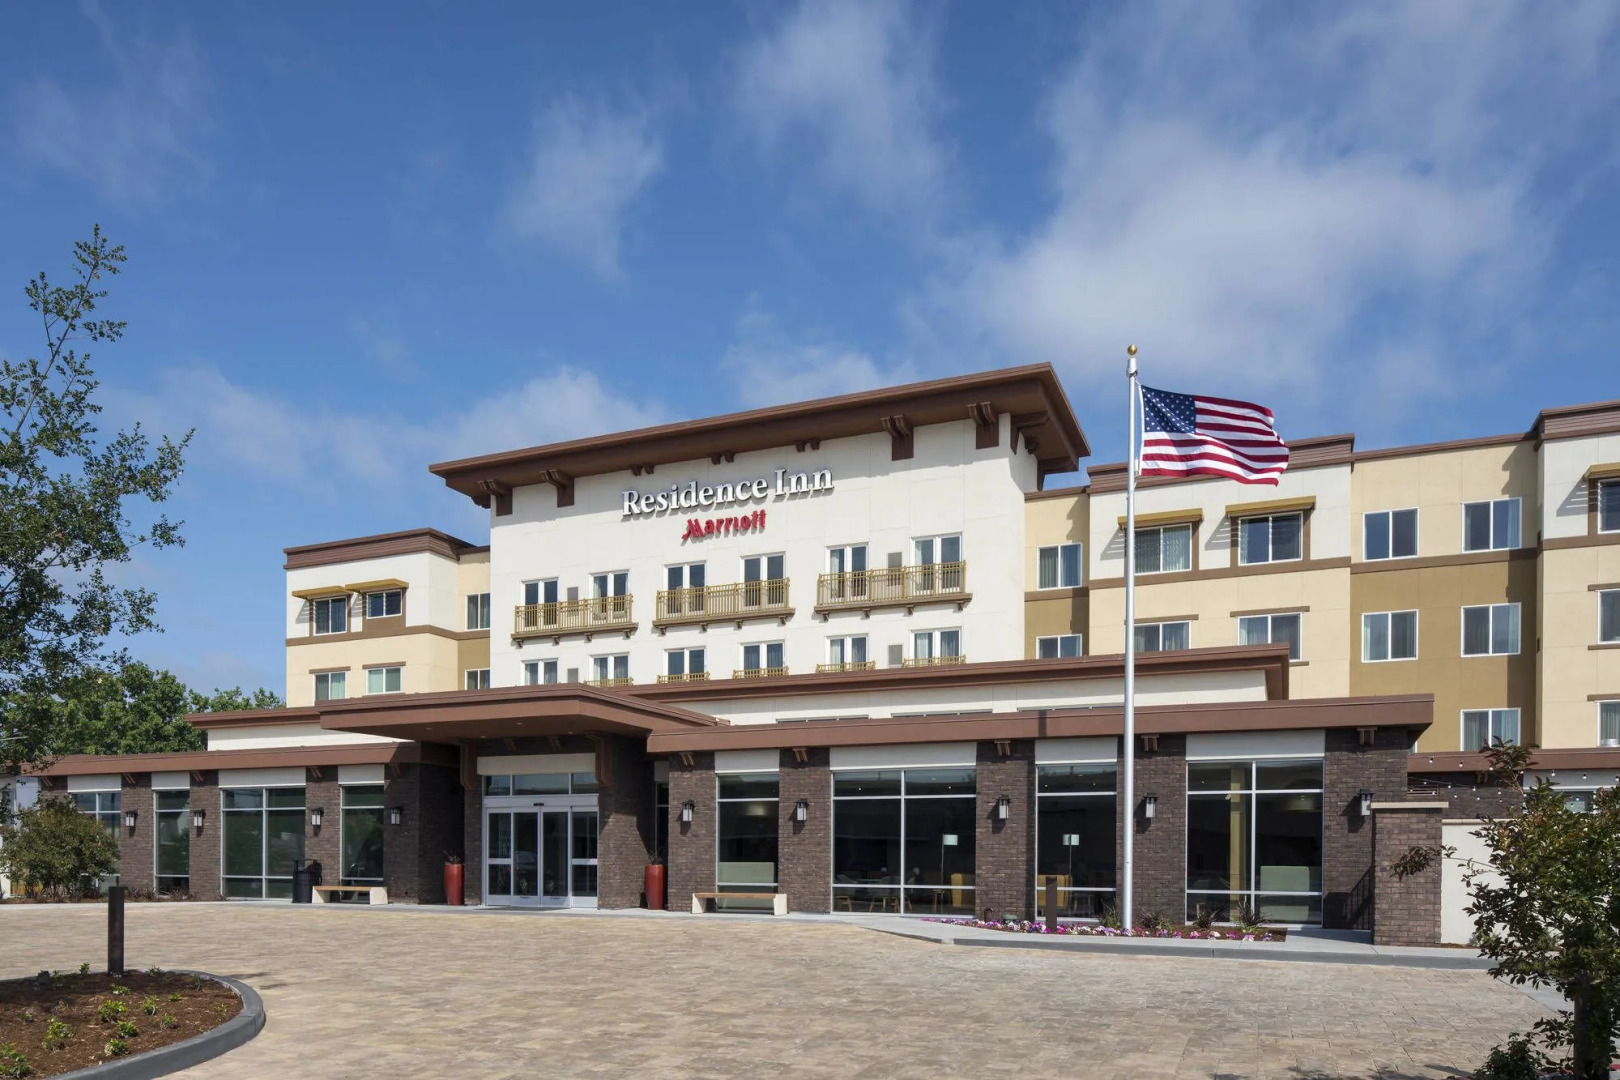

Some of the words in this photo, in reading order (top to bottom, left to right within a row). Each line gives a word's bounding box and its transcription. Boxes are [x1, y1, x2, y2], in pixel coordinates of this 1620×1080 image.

[622, 480, 769, 516] Residence
[774, 468, 834, 496] Inn
[681, 509, 767, 541] Marriott
